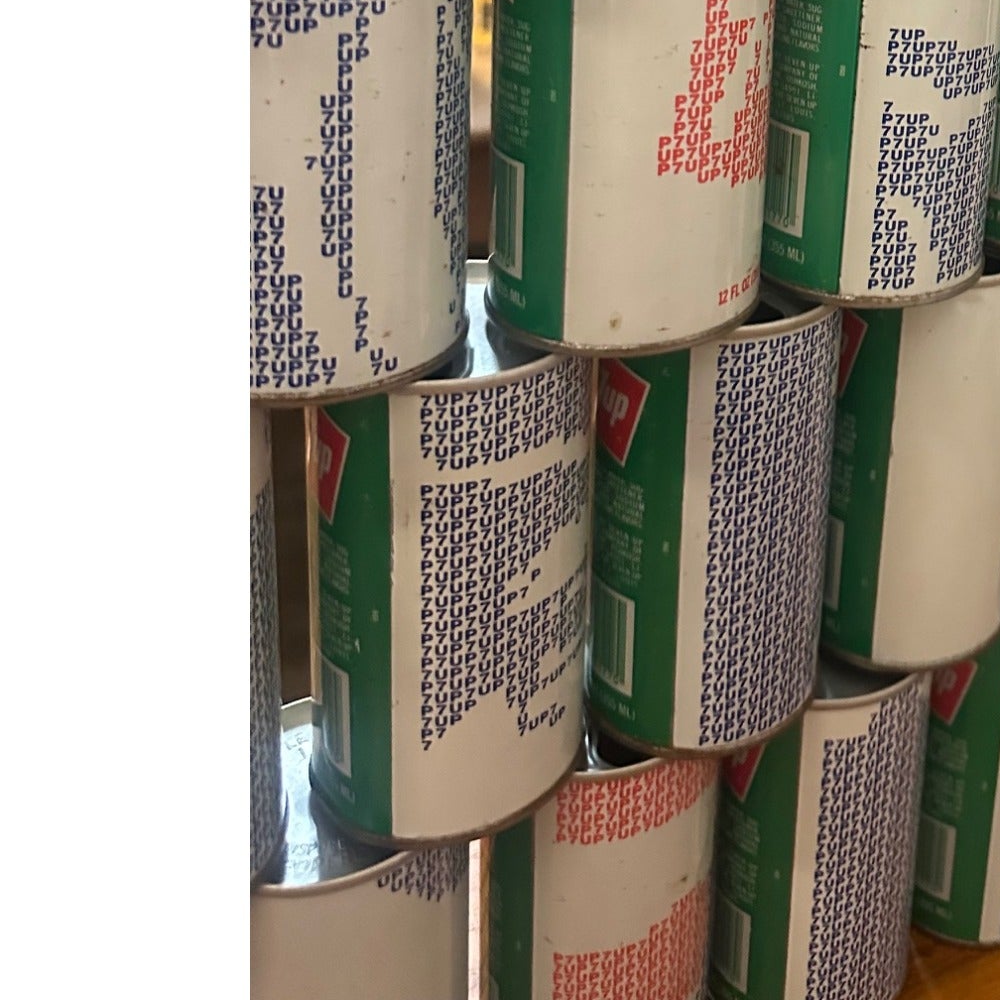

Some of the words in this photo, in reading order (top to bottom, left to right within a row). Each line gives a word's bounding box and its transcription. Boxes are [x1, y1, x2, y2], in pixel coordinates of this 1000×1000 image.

[890, 29, 926, 40] 7UP
[888, 40, 957, 52] P7UP7U
[675, 90, 724, 108] P7UP
[676, 105, 712, 121] 7UP
[882, 114, 930, 125] P7UP
[674, 118, 711, 135] P7U
[882, 125, 939, 137] 7UP7U
[659, 132, 711, 149] P7UP
[880, 137, 927, 149] P7UP
[874, 209, 896, 220] P7
[874, 221, 908, 232] 7UP
[872, 232, 907, 243] P7U
[872, 244, 917, 255] 7UP7
[870, 255, 916, 267] P7UP
[870, 267, 915, 279] 7UP7
[868, 278, 914, 290] P7UP
[421, 478, 492, 496] P7UP7
[421, 700, 476, 717] P7UP
[421, 715, 462, 727] 7UP
[421, 728, 446, 739] P7
